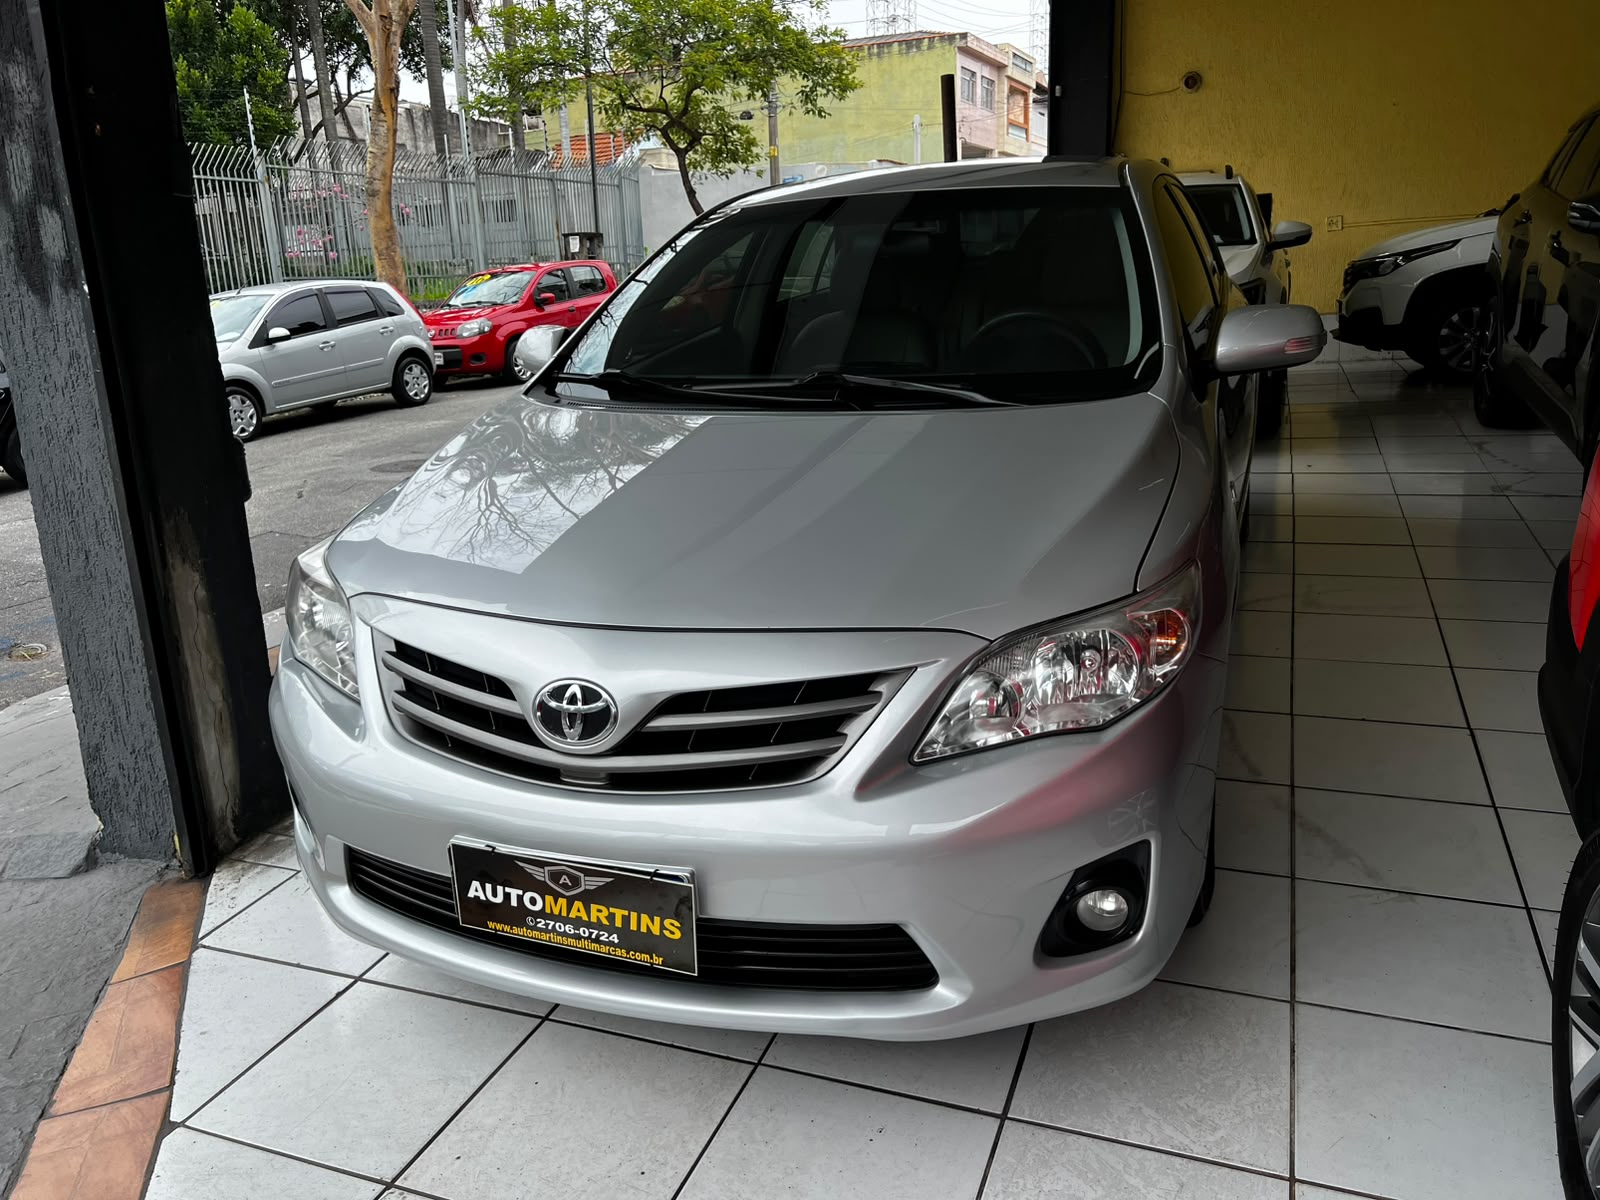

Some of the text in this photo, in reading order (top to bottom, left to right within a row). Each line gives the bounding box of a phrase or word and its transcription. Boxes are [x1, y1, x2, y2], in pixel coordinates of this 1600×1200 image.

[559, 875, 572, 886] A
[467, 880, 682, 940] AUTOMARTINS
[487, 920, 664, 965] www.automartinsmultimarcas.com.br
[536, 918, 619, 943] 2706-0724
